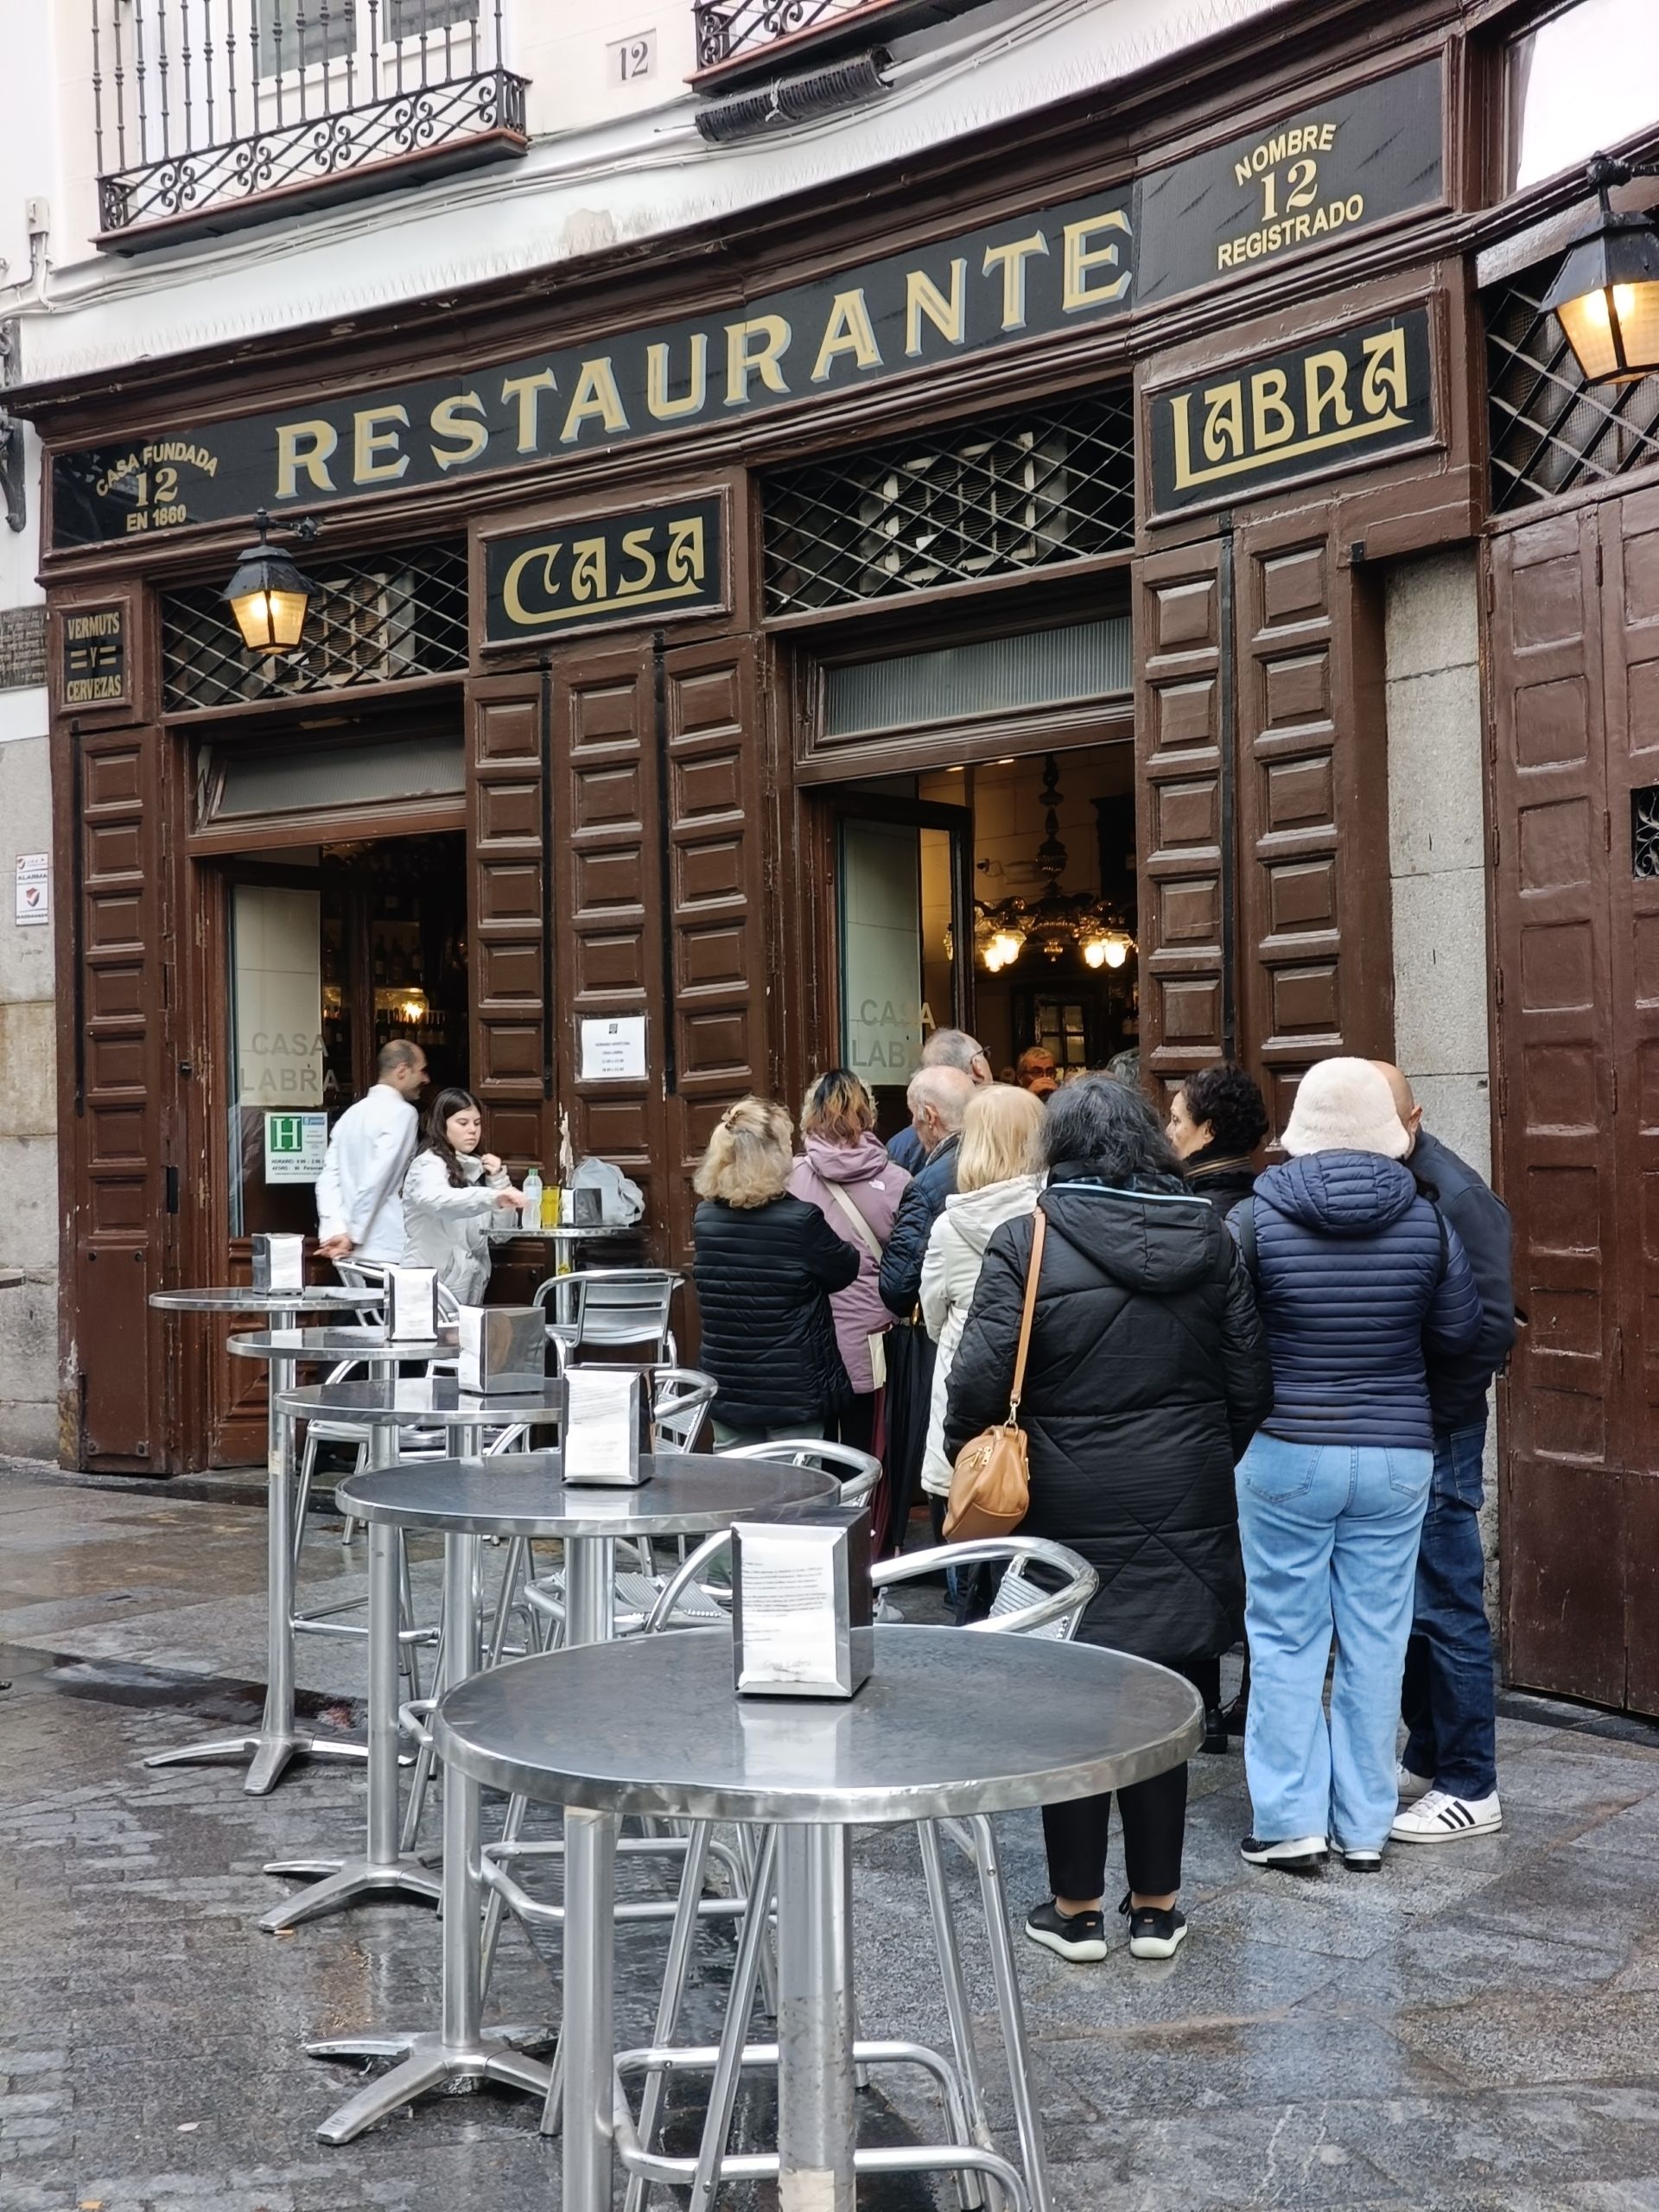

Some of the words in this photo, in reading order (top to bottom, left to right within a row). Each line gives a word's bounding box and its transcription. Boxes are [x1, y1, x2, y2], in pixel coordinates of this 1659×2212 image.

[620, 41, 648, 81] 12
[1235, 124, 1337, 186] NOMBRE
[1261, 159, 1318, 221] 12
[1217, 194, 1363, 270] REGISTRADO
[275, 209, 1133, 499] RESTAURANTE
[1169, 327, 1414, 491] LABRA
[96, 453, 140, 497] CASA
[143, 442, 218, 477] FUNDADA
[136, 467, 178, 507] 12
[127, 512, 148, 531] EN
[153, 505, 186, 526] 1860
[504, 516, 705, 625] CASA
[67, 612, 120, 640] VERMUTS
[90, 647, 97, 668] Y
[67, 675, 121, 702] CERVEZAS
[251, 1033, 328, 1057] CASA
[240, 1068, 340, 1092] LABRA
[273, 1118, 302, 1150] H
